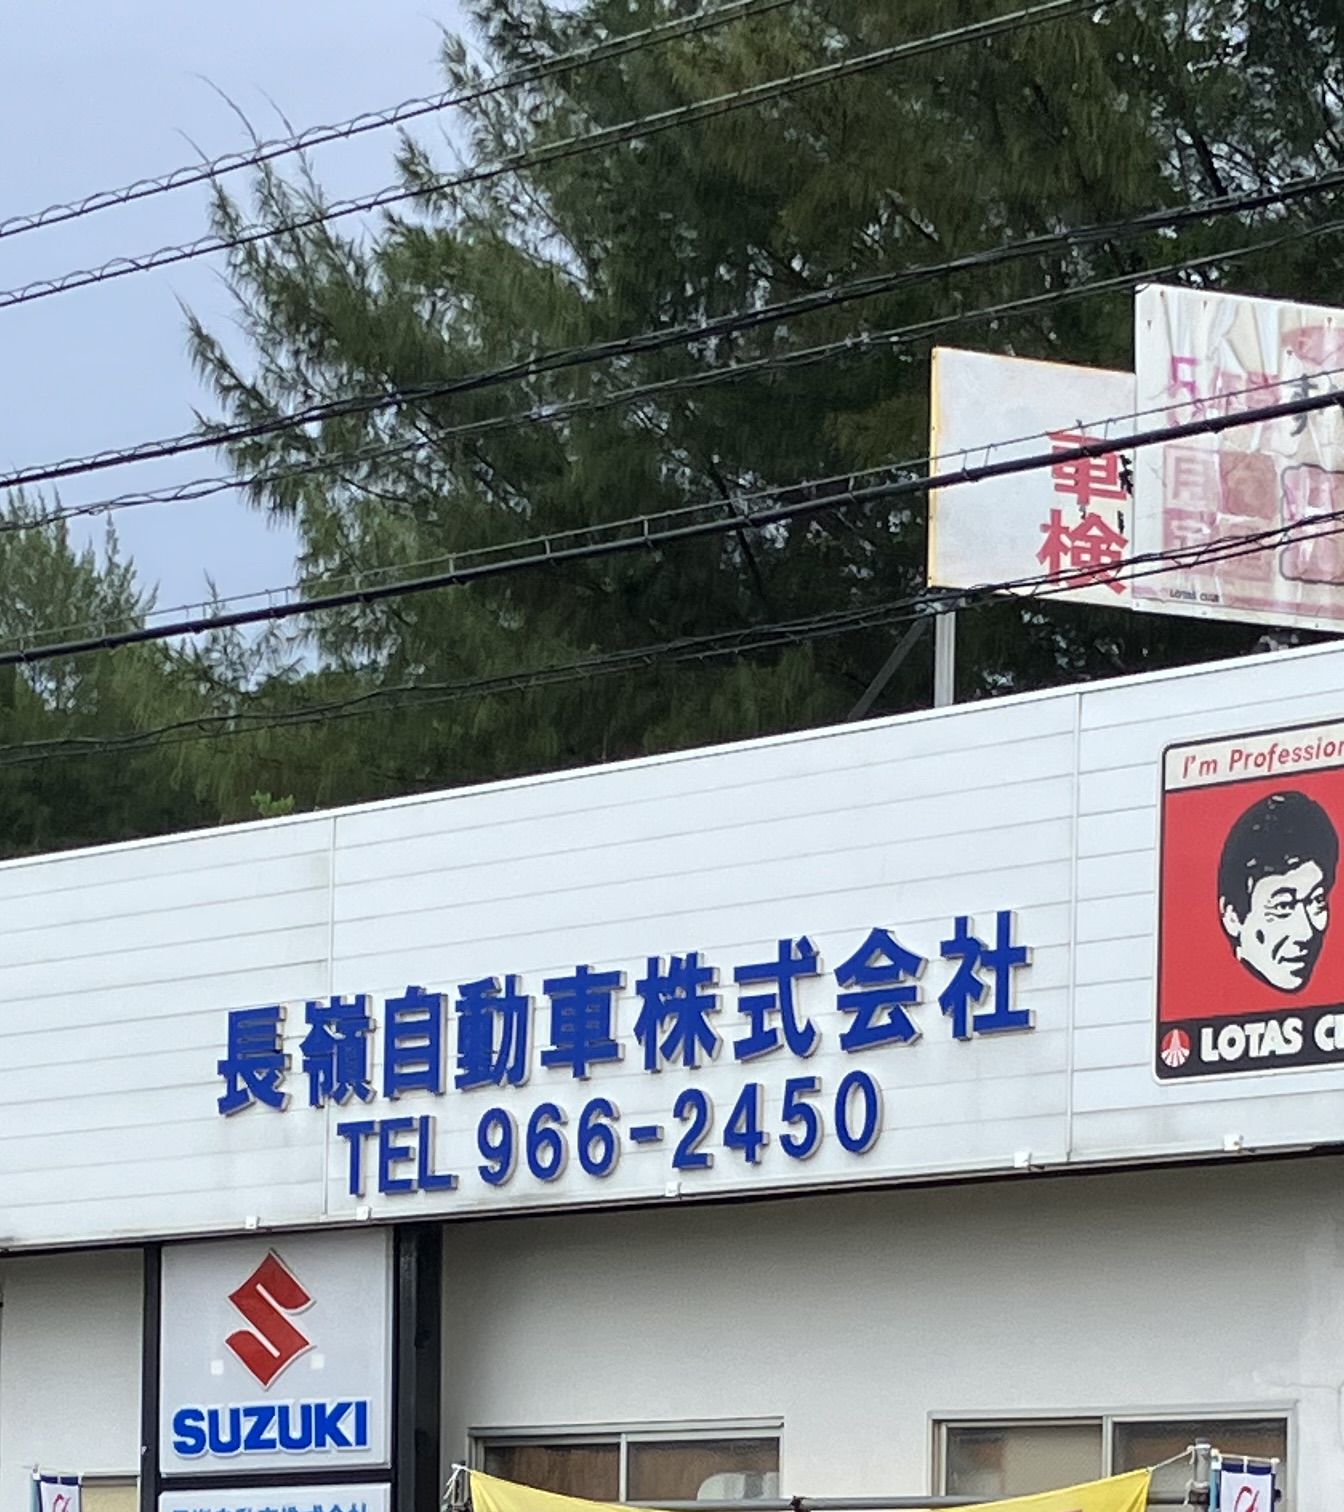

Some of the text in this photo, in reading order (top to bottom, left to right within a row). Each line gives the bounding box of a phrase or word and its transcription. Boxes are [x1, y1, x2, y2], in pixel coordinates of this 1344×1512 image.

[1035, 431, 1130, 596] 車検
[1181, 754, 1219, 780] I'm
[216, 909, 1038, 1117] 長嶺自動車株式会社
[1199, 1016, 1304, 1064] LOTAS
[336, 1069, 884, 1197] TEL 966-2450
[172, 1400, 369, 1455] SUZUKI
